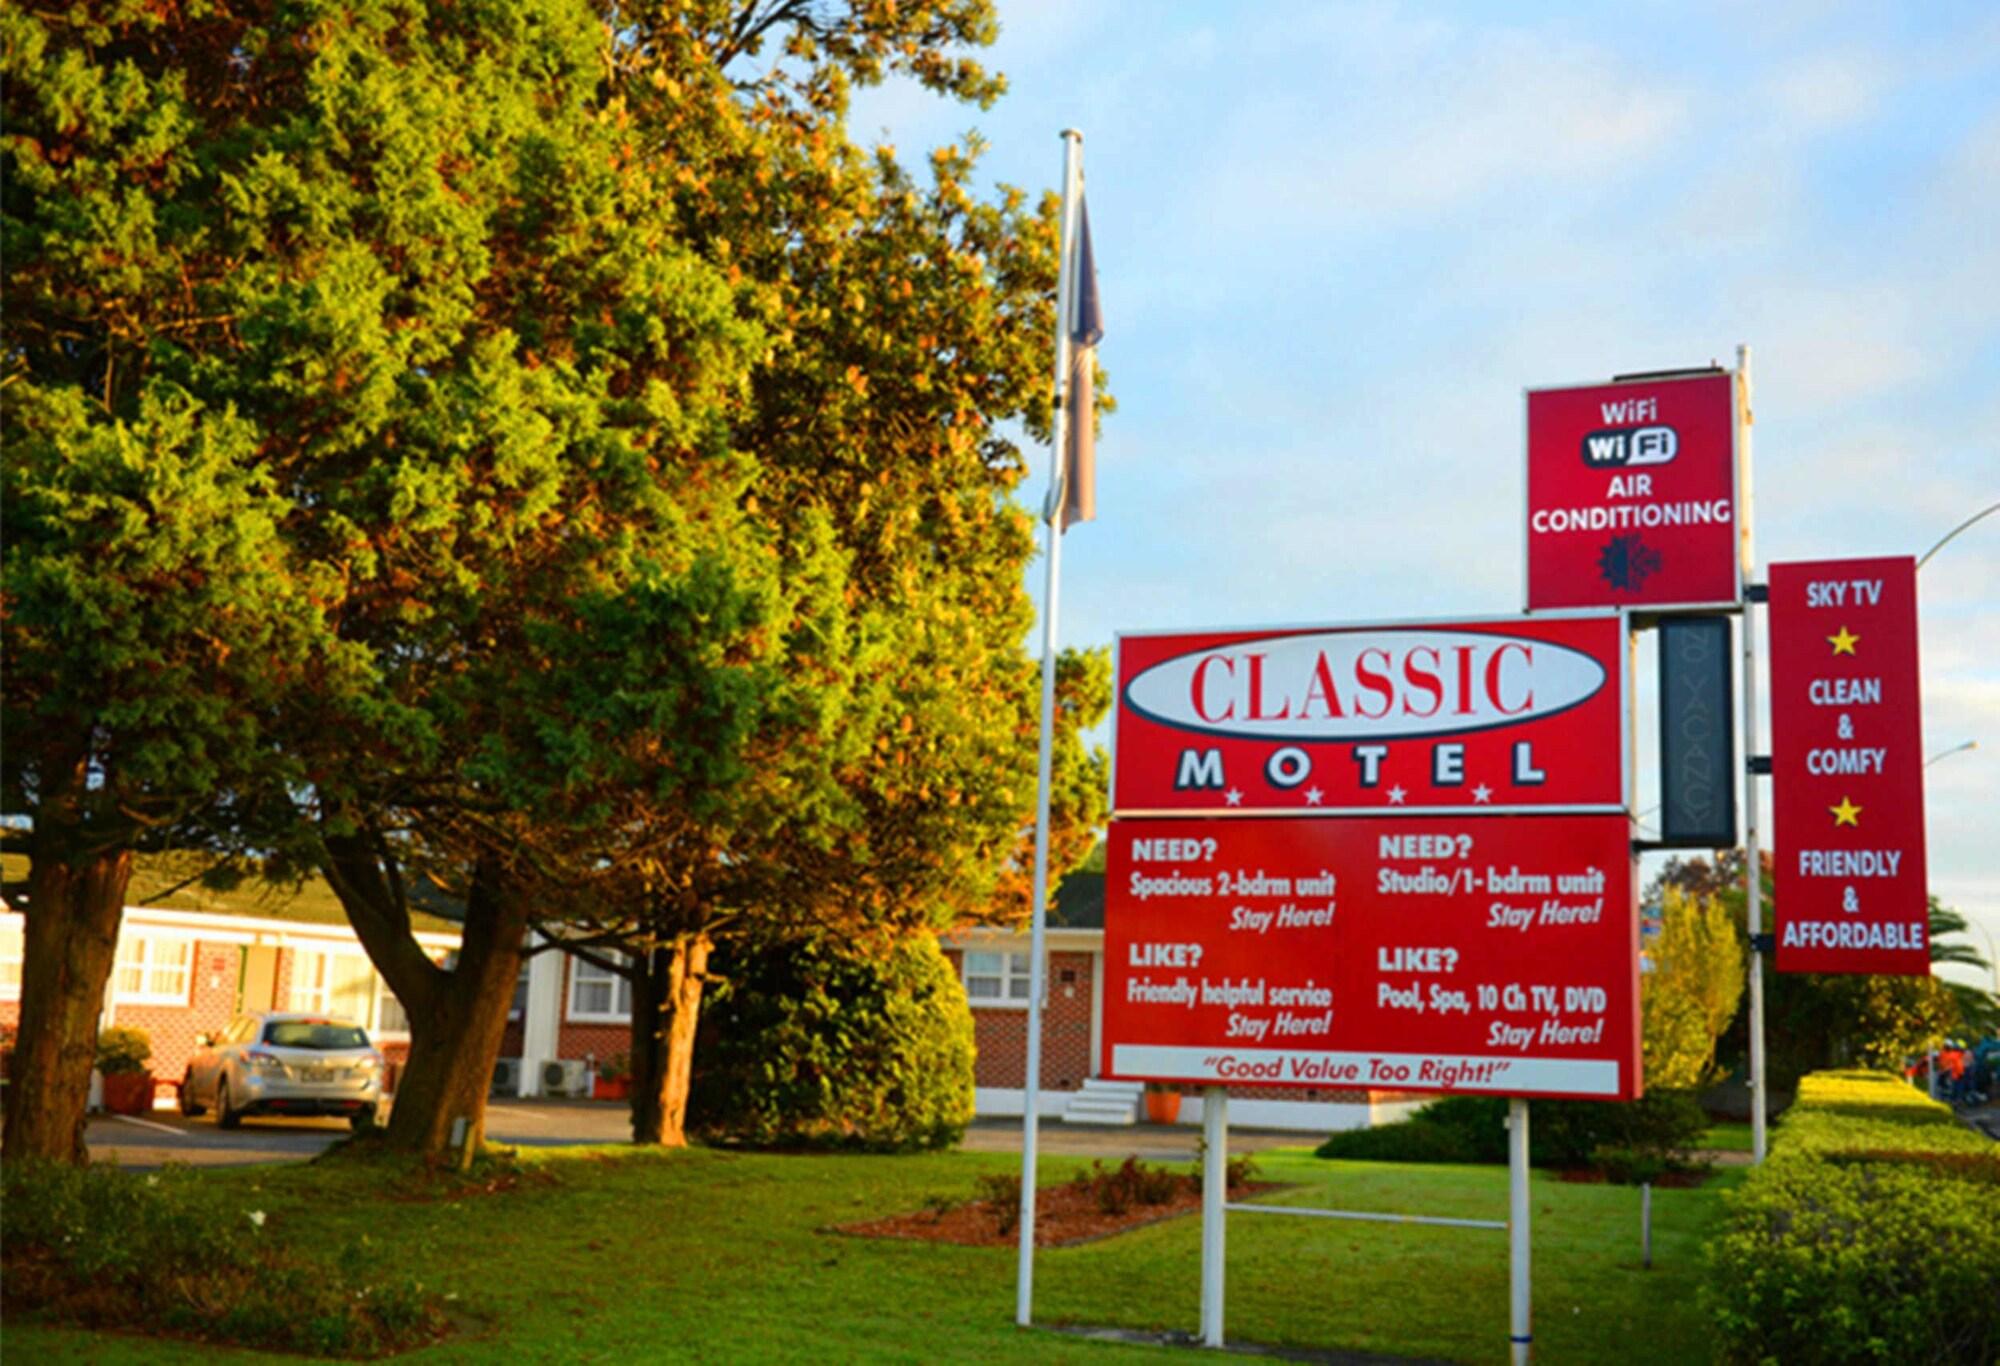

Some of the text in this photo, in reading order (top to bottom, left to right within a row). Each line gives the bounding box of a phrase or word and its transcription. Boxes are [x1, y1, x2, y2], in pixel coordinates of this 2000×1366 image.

[1601, 398, 1657, 424] WiFi
[1607, 474, 1652, 498] AIR
[1533, 500, 1731, 533] CONDITIONING
[1807, 580, 1882, 607] SKY TV
[1190, 643, 1535, 723] CLASSIC
[1809, 679, 1880, 705] CLEAN
[1837, 714, 1853, 739] &
[1174, 741, 1546, 790] MOTEL
[1807, 749, 1886, 775] COMFY
[1132, 838, 1217, 861] NEED?
[1380, 835, 1472, 858] NEED?
[1799, 850, 1901, 876] FRIENDLY
[1130, 870, 1335, 900] Spacious 2-bdrm unit
[1488, 868, 1550, 893] bdrm
[1557, 868, 1604, 893] unit
[1843, 886, 1859, 913] &
[1230, 903, 1334, 933] Stay Here!
[1487, 899, 1602, 931] Stay Here!
[1783, 923, 1923, 950] AFFORDABLE
[1129, 944, 1203, 967] LIKE?
[1379, 948, 1458, 972] LIKE?
[1127, 979, 1332, 1007] Friendly helpful service
[1378, 983, 1606, 1016] Pool, Spa, 10 Ch TV, DVD
[1227, 1011, 1332, 1041] Stay Here!
[1487, 1019, 1602, 1051] Stay Here!
[1289, 1057, 1358, 1080] Value
[1369, 1059, 1409, 1080] Too
